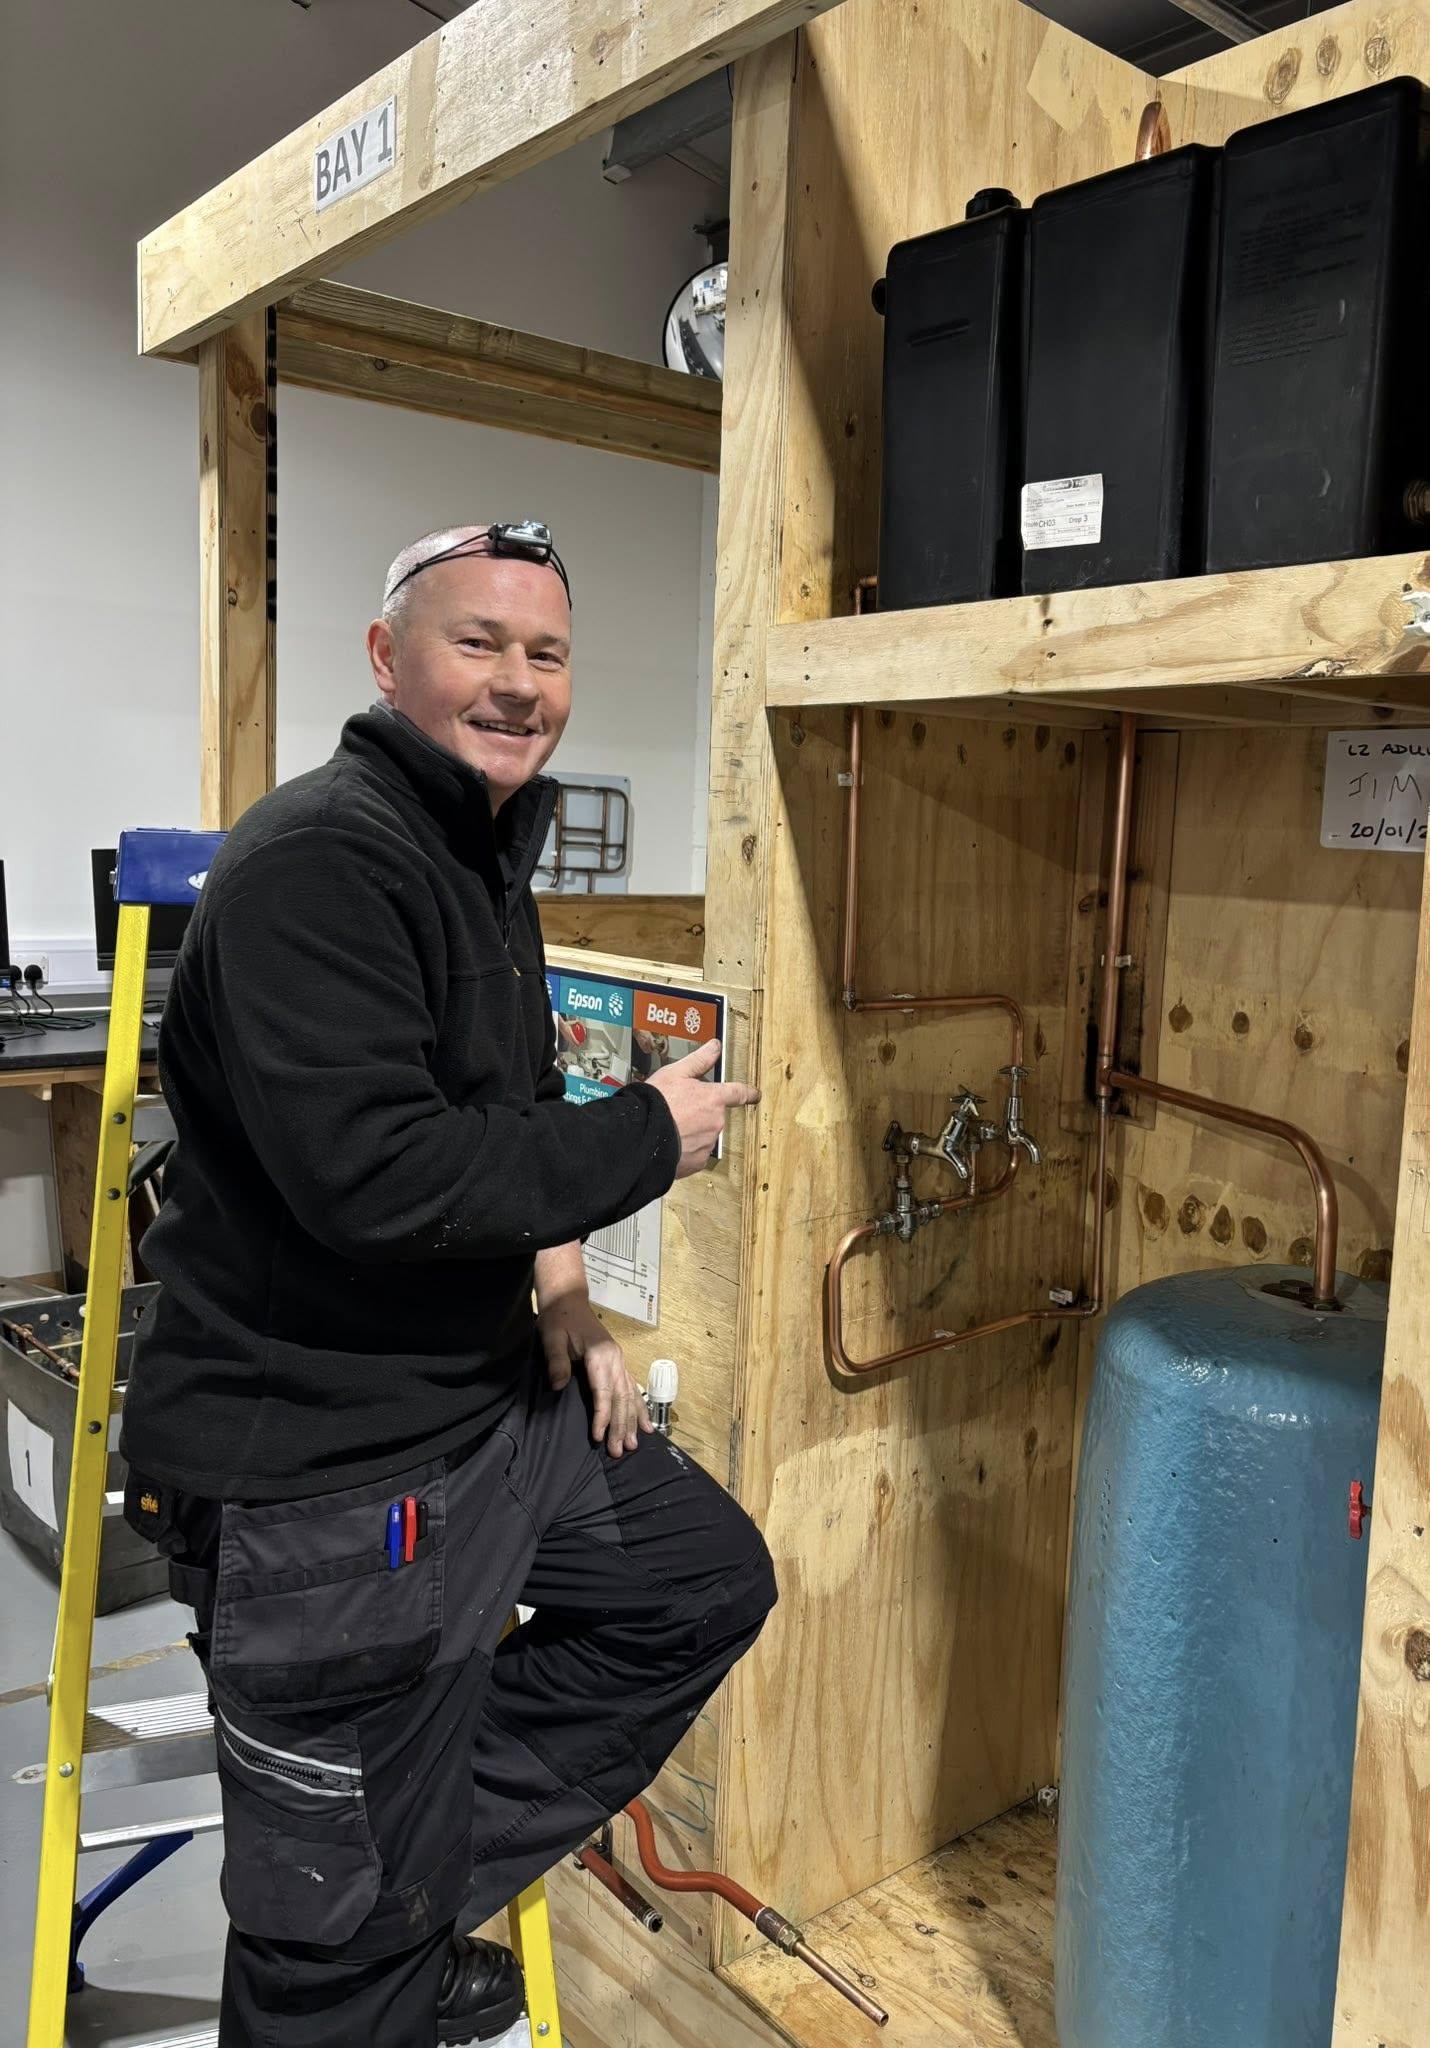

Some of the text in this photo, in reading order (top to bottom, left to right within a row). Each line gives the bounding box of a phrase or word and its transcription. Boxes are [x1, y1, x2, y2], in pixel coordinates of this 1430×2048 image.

[317, 106, 392, 201] BAY 1
[1348, 772, 1422, 802] JIM
[1350, 818, 1428, 845] 20/01/2
[567, 988, 603, 1012] Epson
[646, 1003, 678, 1027] Beta
